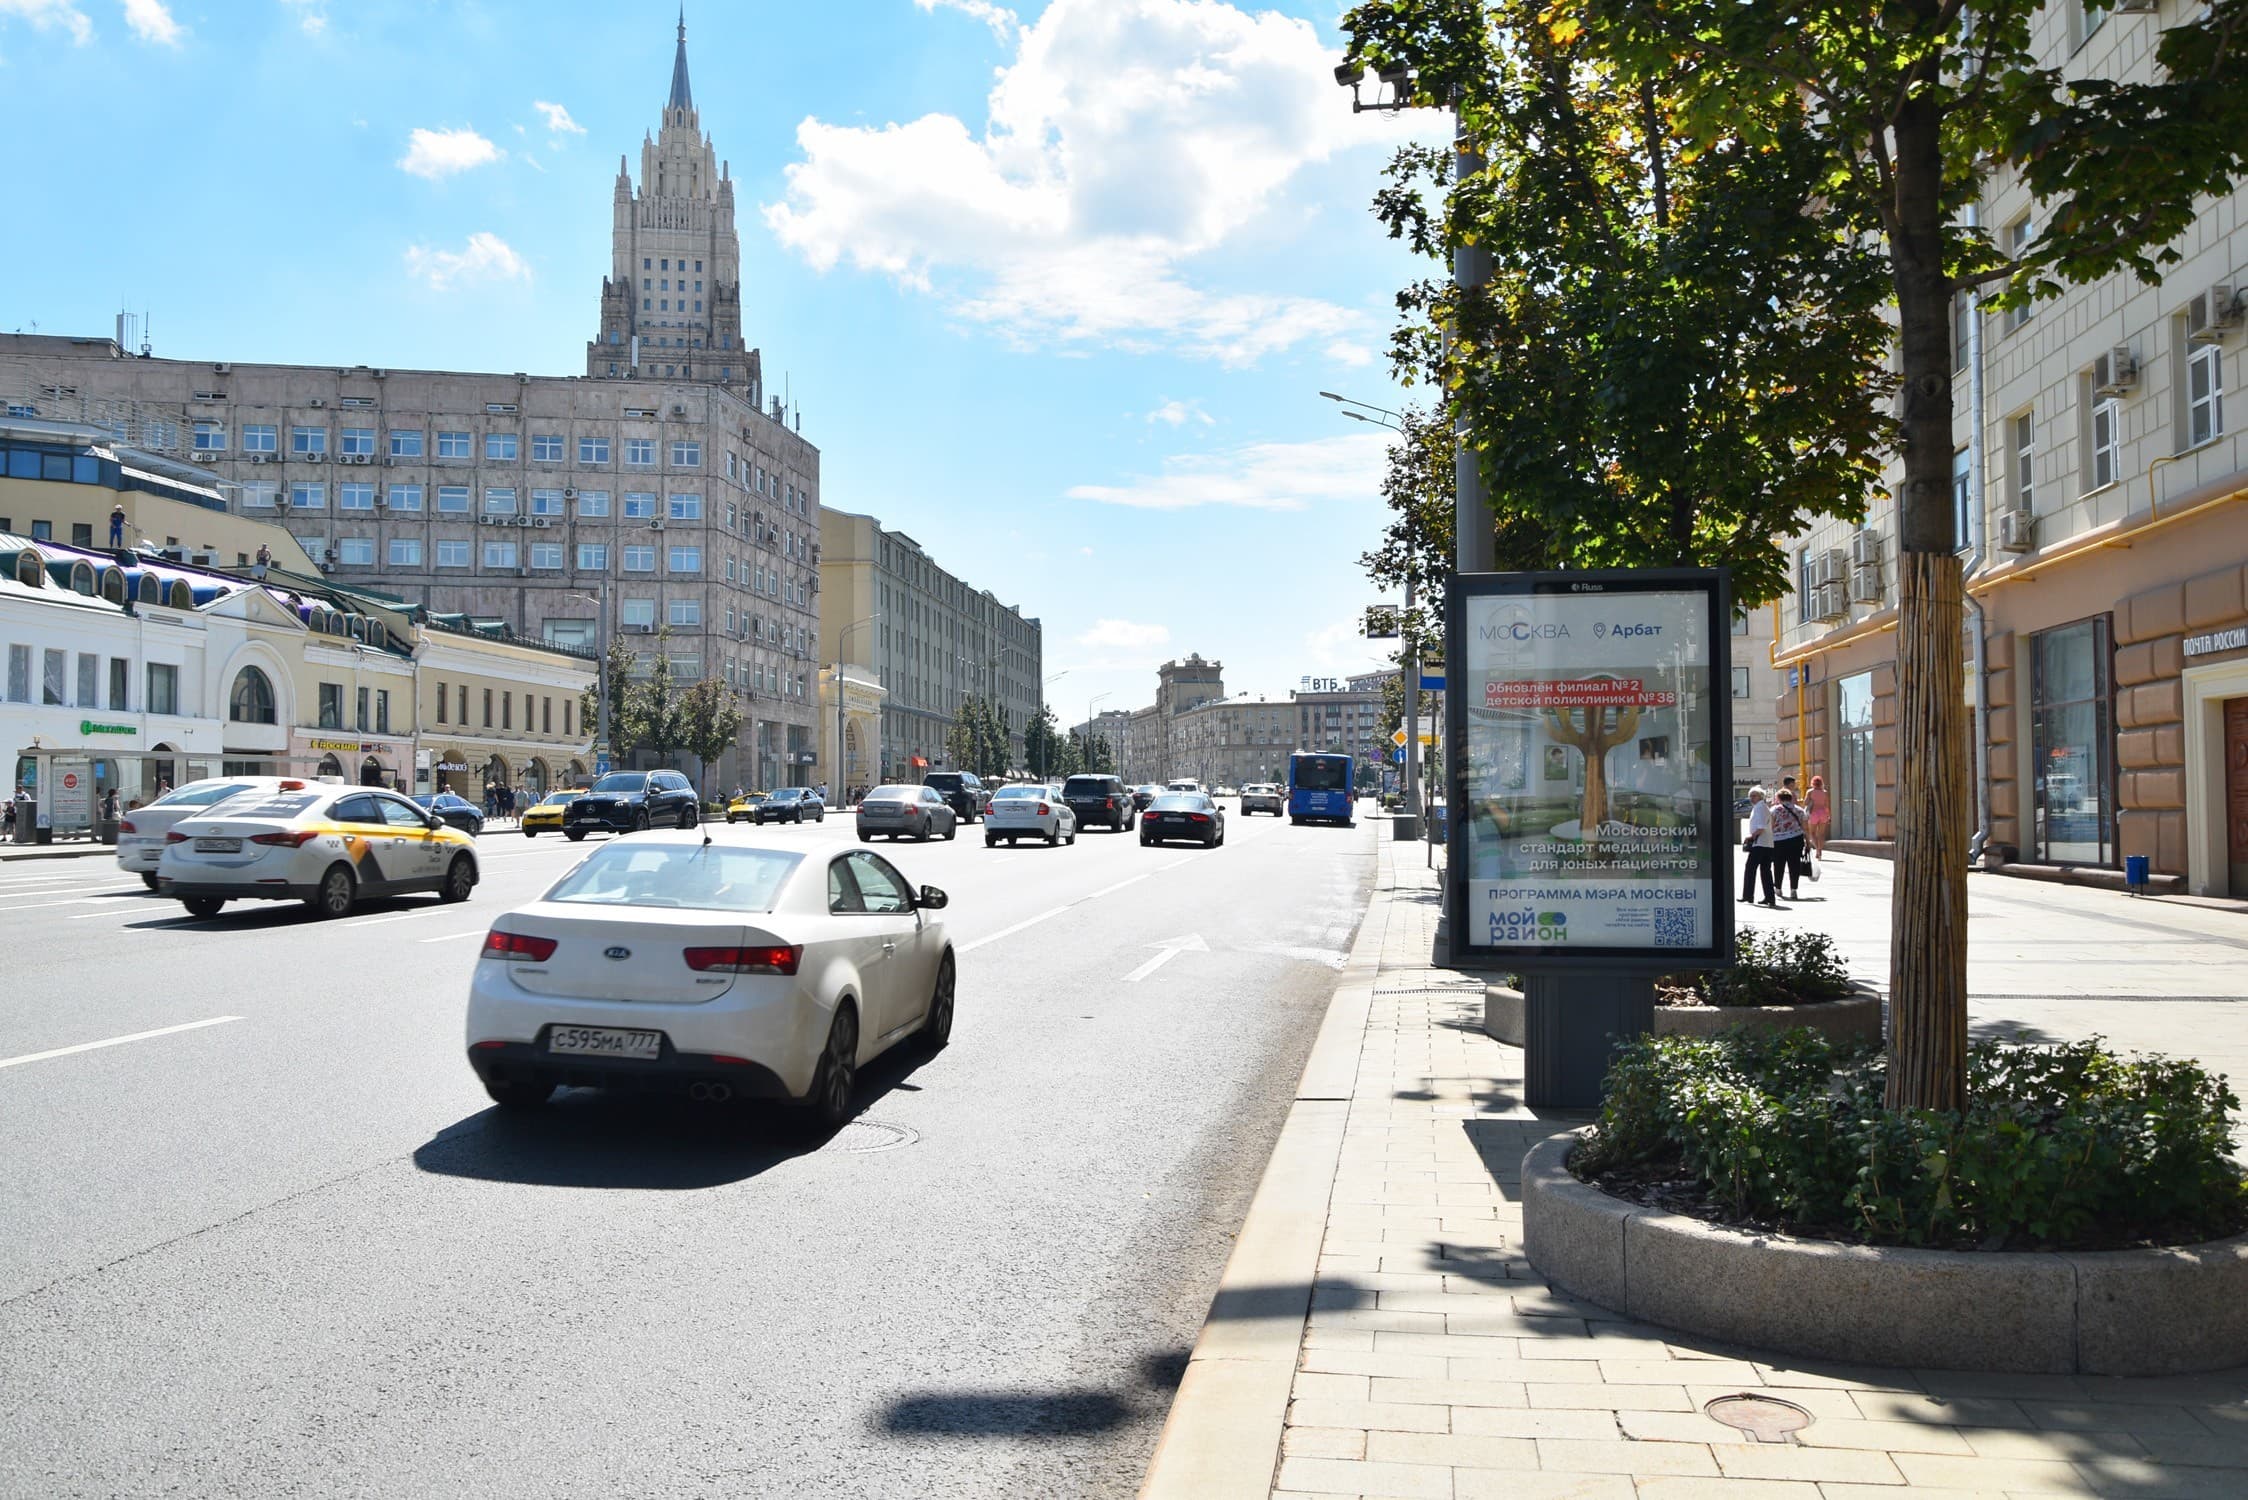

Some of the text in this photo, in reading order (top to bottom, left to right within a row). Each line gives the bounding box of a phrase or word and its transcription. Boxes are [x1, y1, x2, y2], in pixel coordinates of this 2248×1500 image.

[1582, 583, 1603, 591] Russ
[1480, 622, 1570, 640] МОСКВА
[1612, 624, 1662, 640] Арбат
[2183, 628, 2246, 656] ПОЧТА РОССИИ
[1313, 678, 1338, 690] ВТБ
[1486, 682, 1553, 693] Обновлён
[1556, 681, 1608, 692] филиал
[1486, 694, 1541, 706] детской
[1544, 694, 1634, 705] поликлиники
[1595, 823, 1698, 836] Московский
[1520, 843, 1594, 854] стандарт
[1599, 842, 1682, 854] медицины
[1529, 859, 1698, 872] для юных пациентов
[1489, 888, 1696, 900] ПРОГРАММА МЭРА МОСКВЫ
